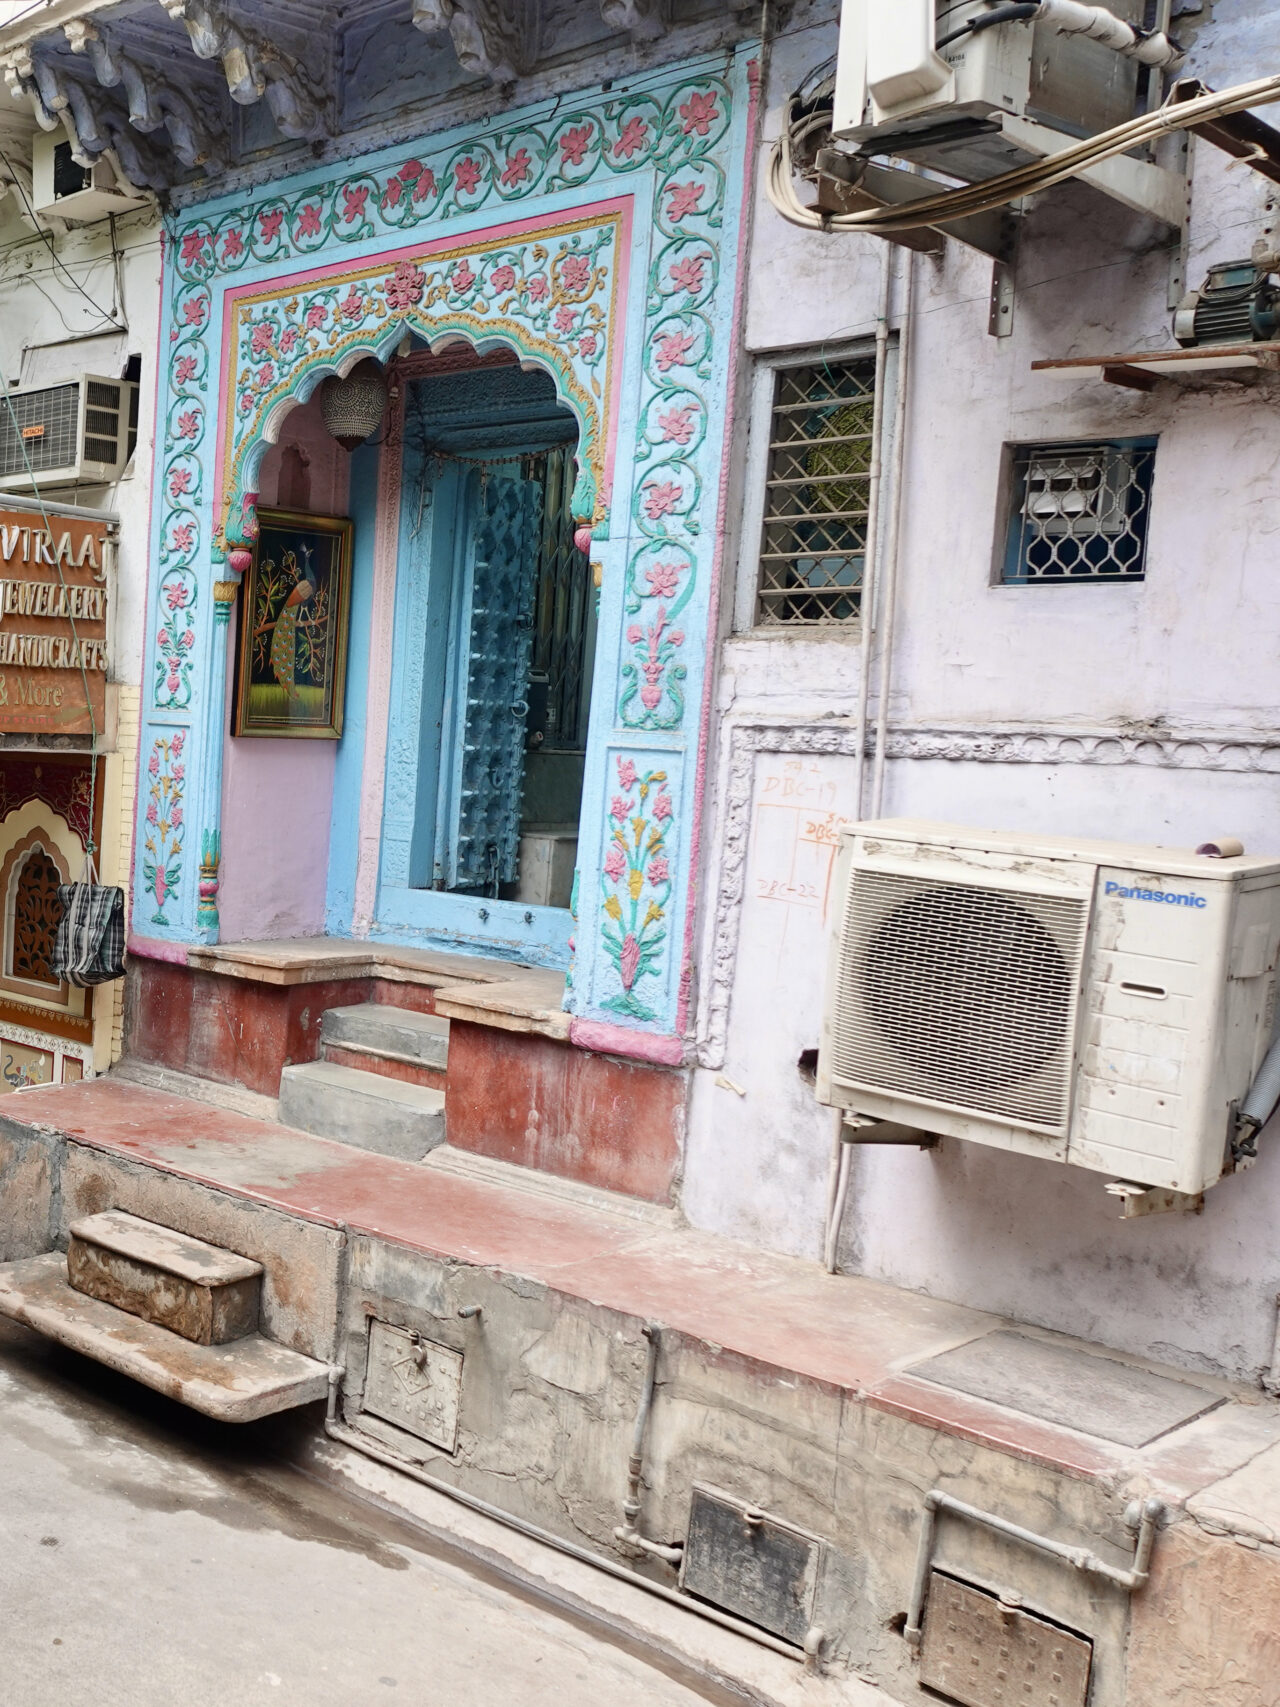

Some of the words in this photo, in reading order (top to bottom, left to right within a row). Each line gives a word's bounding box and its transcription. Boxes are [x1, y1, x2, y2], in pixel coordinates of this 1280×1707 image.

[23, 427, 43, 437] HITACHI
[14, 676, 63, 707] More
[806, 821, 841, 840] DBC-
[1104, 881, 1207, 909] Panasonic
